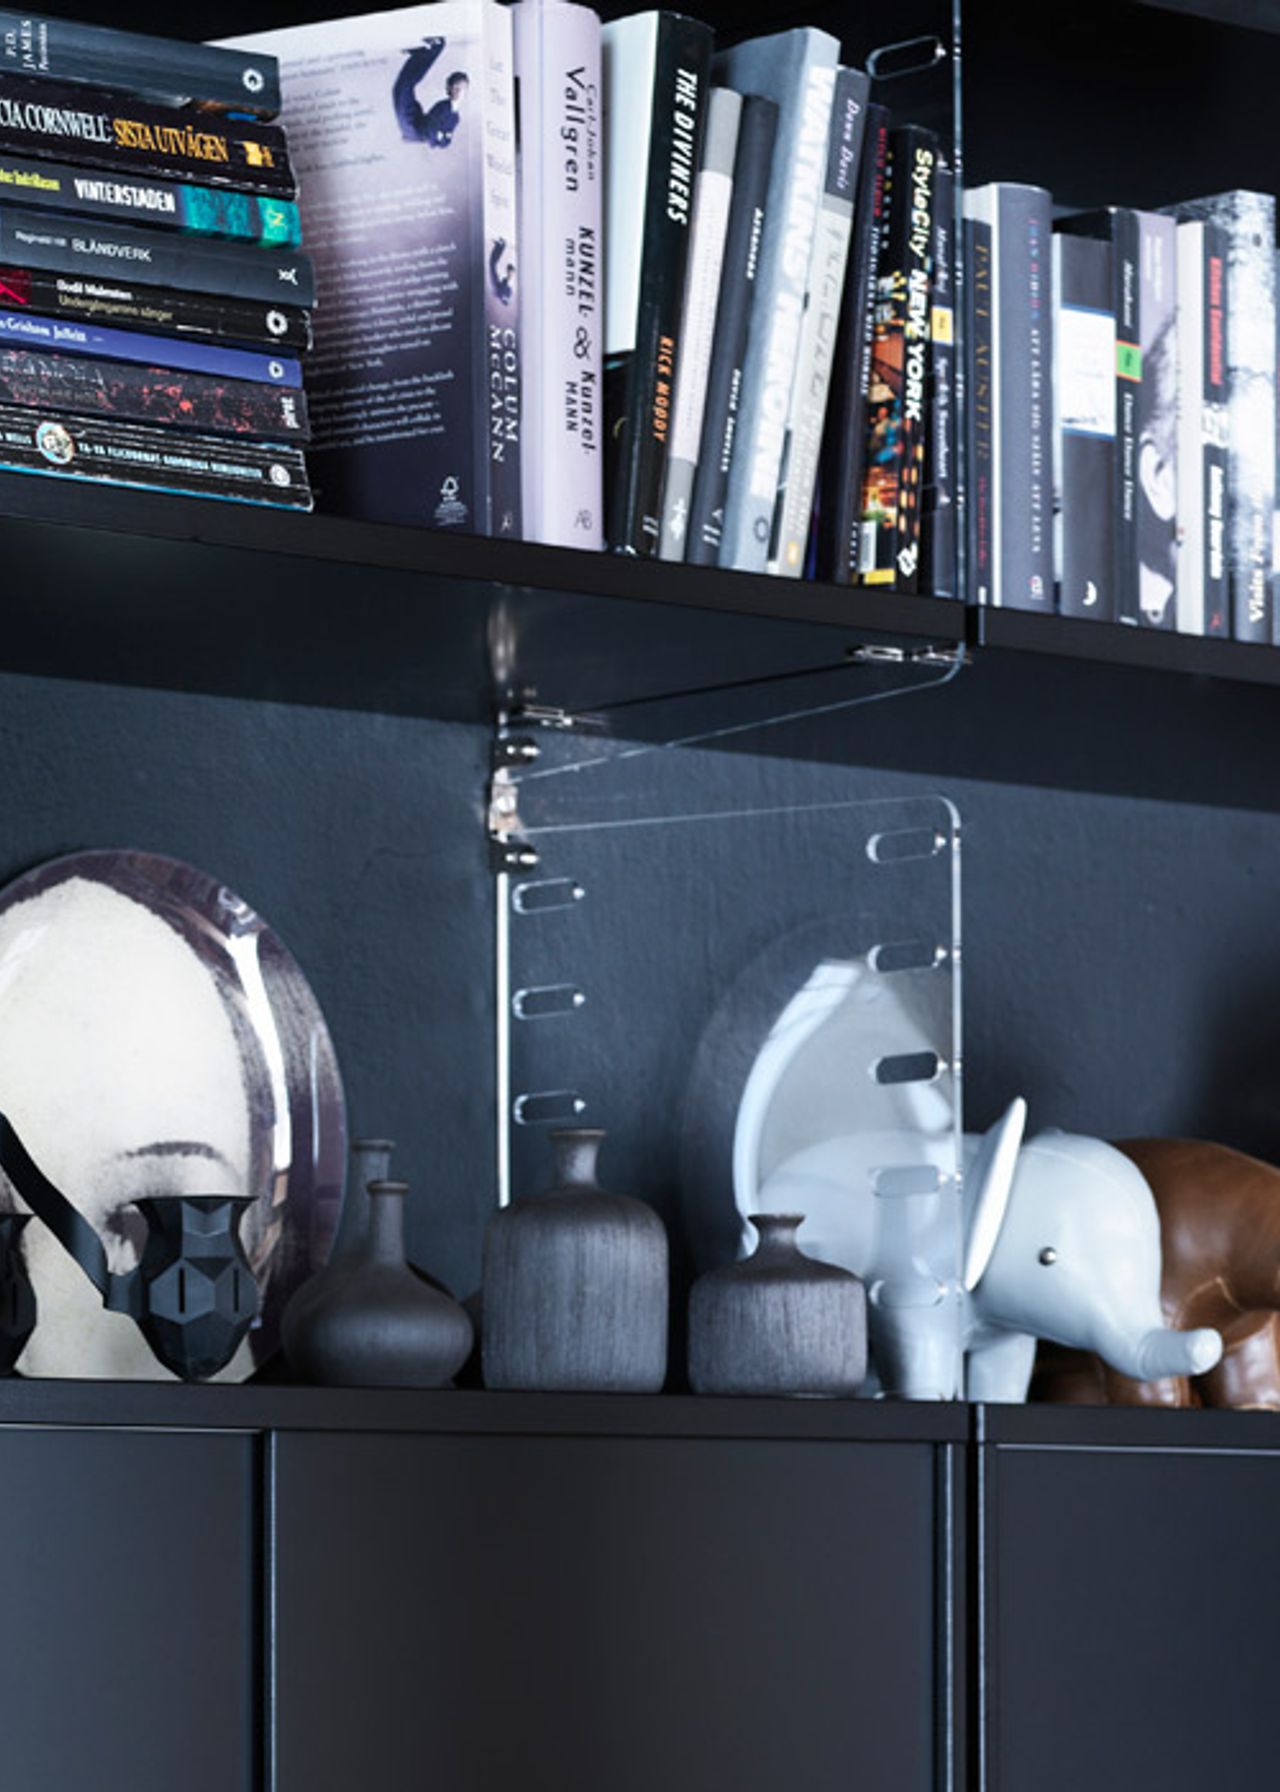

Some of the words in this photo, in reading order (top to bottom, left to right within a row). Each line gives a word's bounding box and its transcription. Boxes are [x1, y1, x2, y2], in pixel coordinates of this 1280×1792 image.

[22, 20, 34, 70] JAMES
[675, 67, 698, 112] THE
[24, 104, 112, 144] CORNWELL
[113, 121, 155, 151] SISTA
[560, 66, 586, 192] Vallgren
[842, 97, 862, 142] Dawn
[666, 111, 696, 227] DIVINERS
[836, 144, 855, 191] Davis
[74, 179, 176, 212] VINTERSTADEN
[909, 148, 934, 258] StyleCity
[566, 238, 575, 296] mann
[906, 268, 929, 340] NEW
[657, 335, 675, 377] RICK
[905, 342, 926, 422] YORK
[489, 324, 504, 462] McCANN
[503, 327, 518, 441] COLUM
[566, 381, 579, 432] MANN
[652, 381, 671, 443] MOODY
